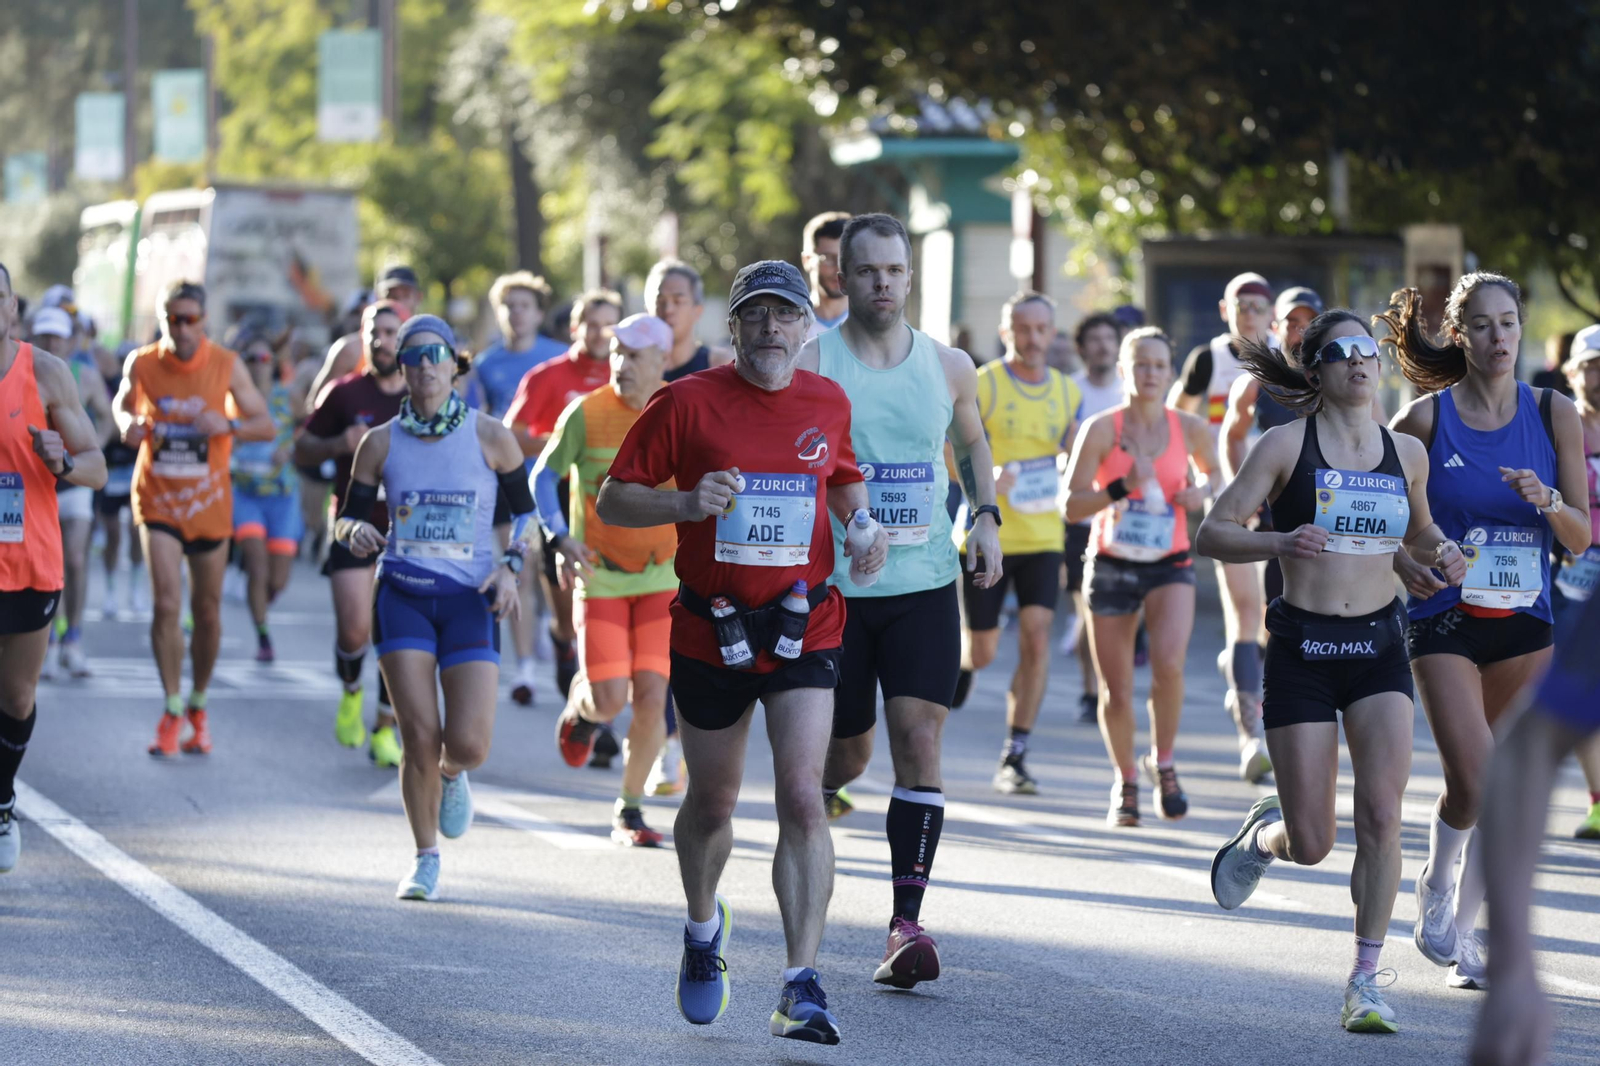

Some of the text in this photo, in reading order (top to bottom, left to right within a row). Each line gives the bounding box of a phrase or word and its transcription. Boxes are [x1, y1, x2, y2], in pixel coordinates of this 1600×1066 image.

[742, 265, 793, 285] CYPRUS
[881, 468, 926, 479] ZURICH
[751, 479, 805, 491] ZURICH
[1348, 476, 1396, 491] ZURICH
[424, 493, 467, 504] ZURICH
[881, 492, 907, 503] 5593
[752, 506, 780, 518] 7145
[1350, 500, 1377, 512] 4867
[1334, 516, 1387, 535] ELENA
[747, 524, 784, 542] ADE
[1493, 532, 1534, 543] ZURICH
[1495, 556, 1517, 566] 7596
[1489, 571, 1520, 588] LINA
[1340, 640, 1375, 654] MAX
